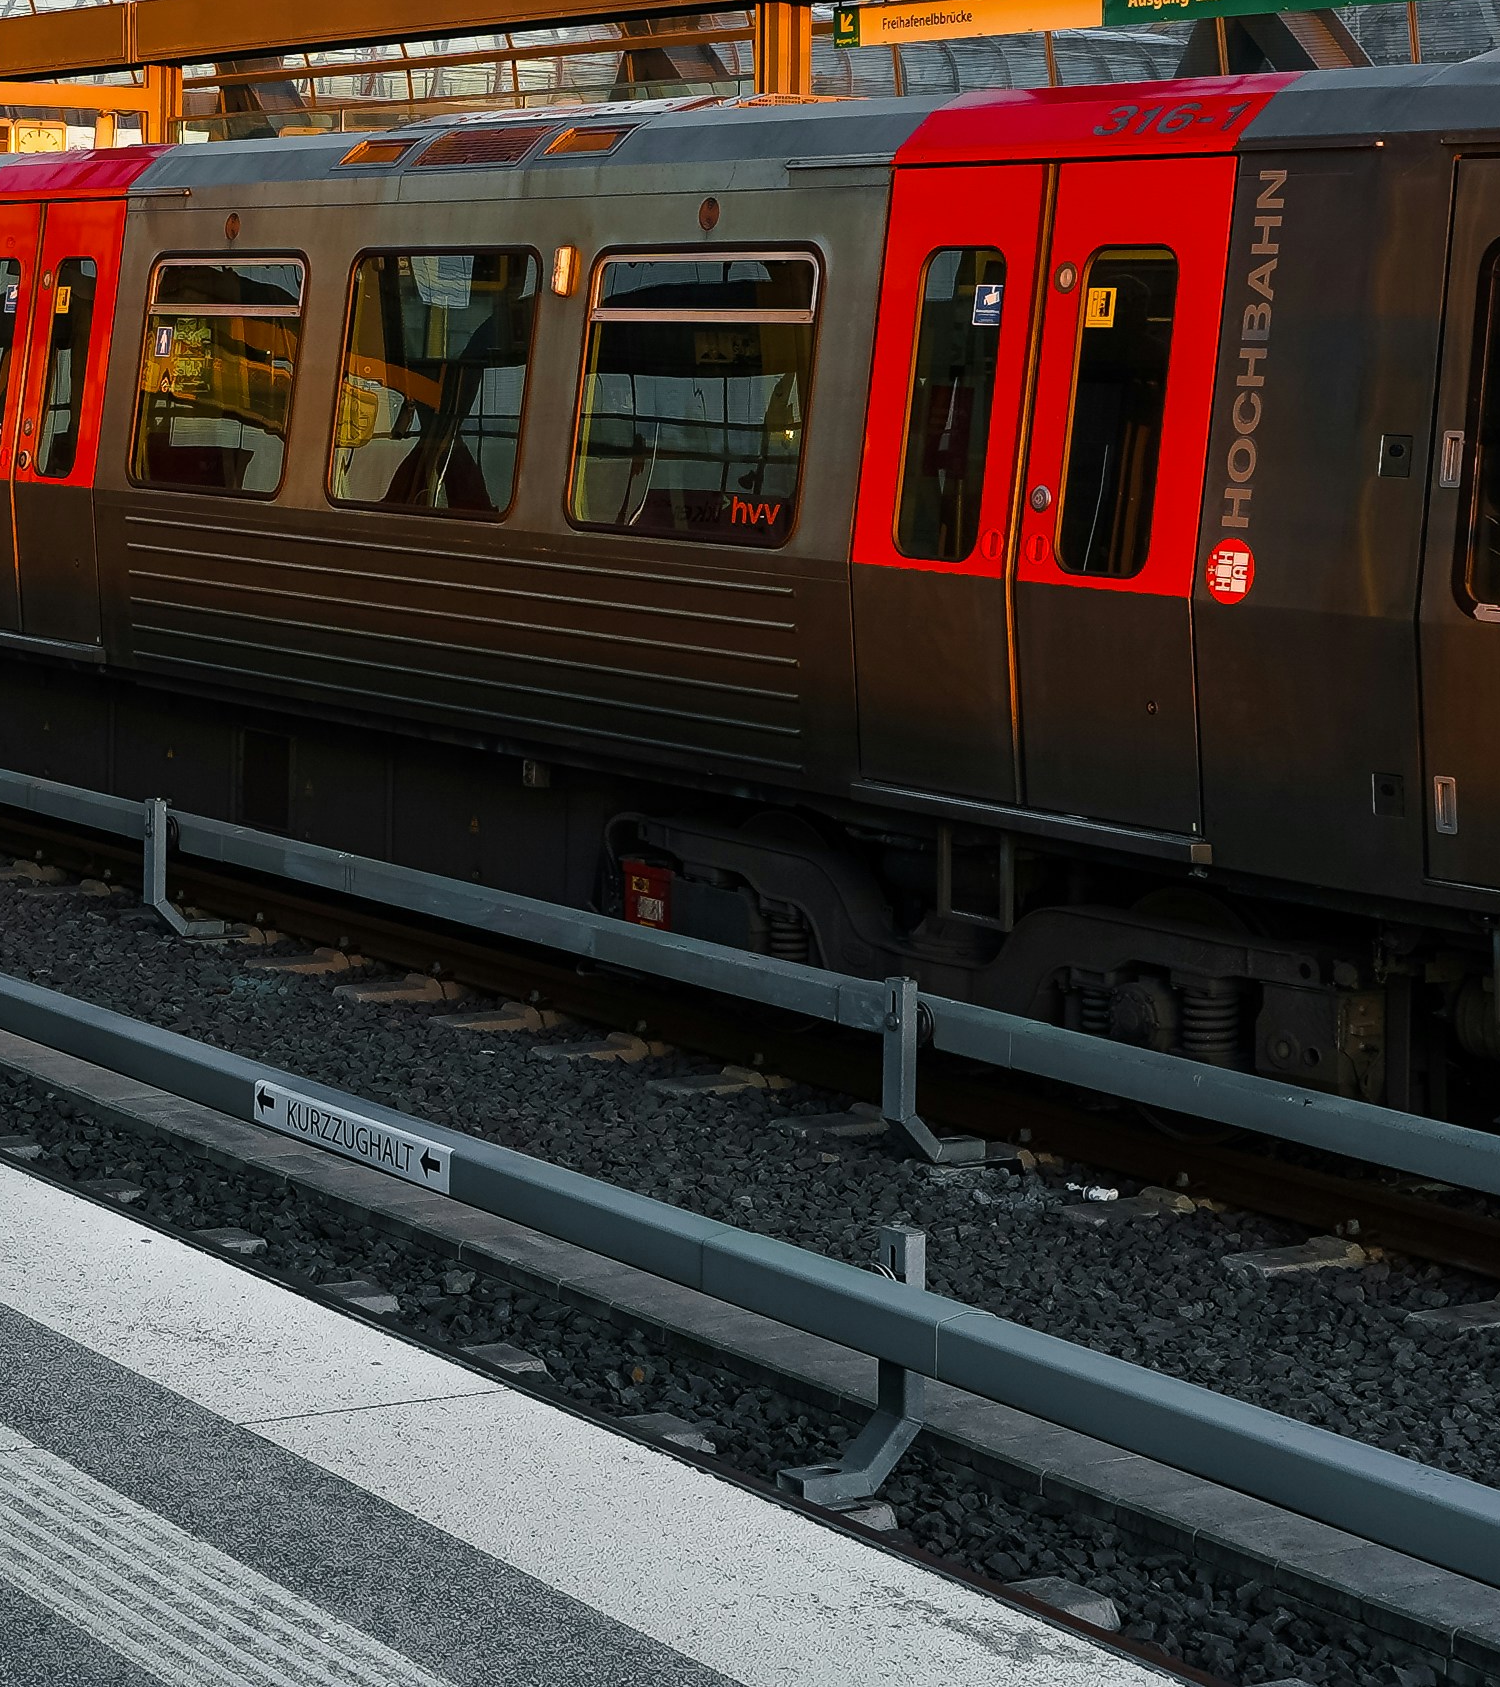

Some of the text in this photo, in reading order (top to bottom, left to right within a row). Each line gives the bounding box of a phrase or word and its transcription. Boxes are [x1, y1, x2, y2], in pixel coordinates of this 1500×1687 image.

[882, 10, 973, 31] Freihafenelbbrücke
[1092, 101, 1252, 137] 316-1
[1221, 170, 1288, 529] HOCHBAHN
[286, 1099, 415, 1173] KURZZUGHALT
